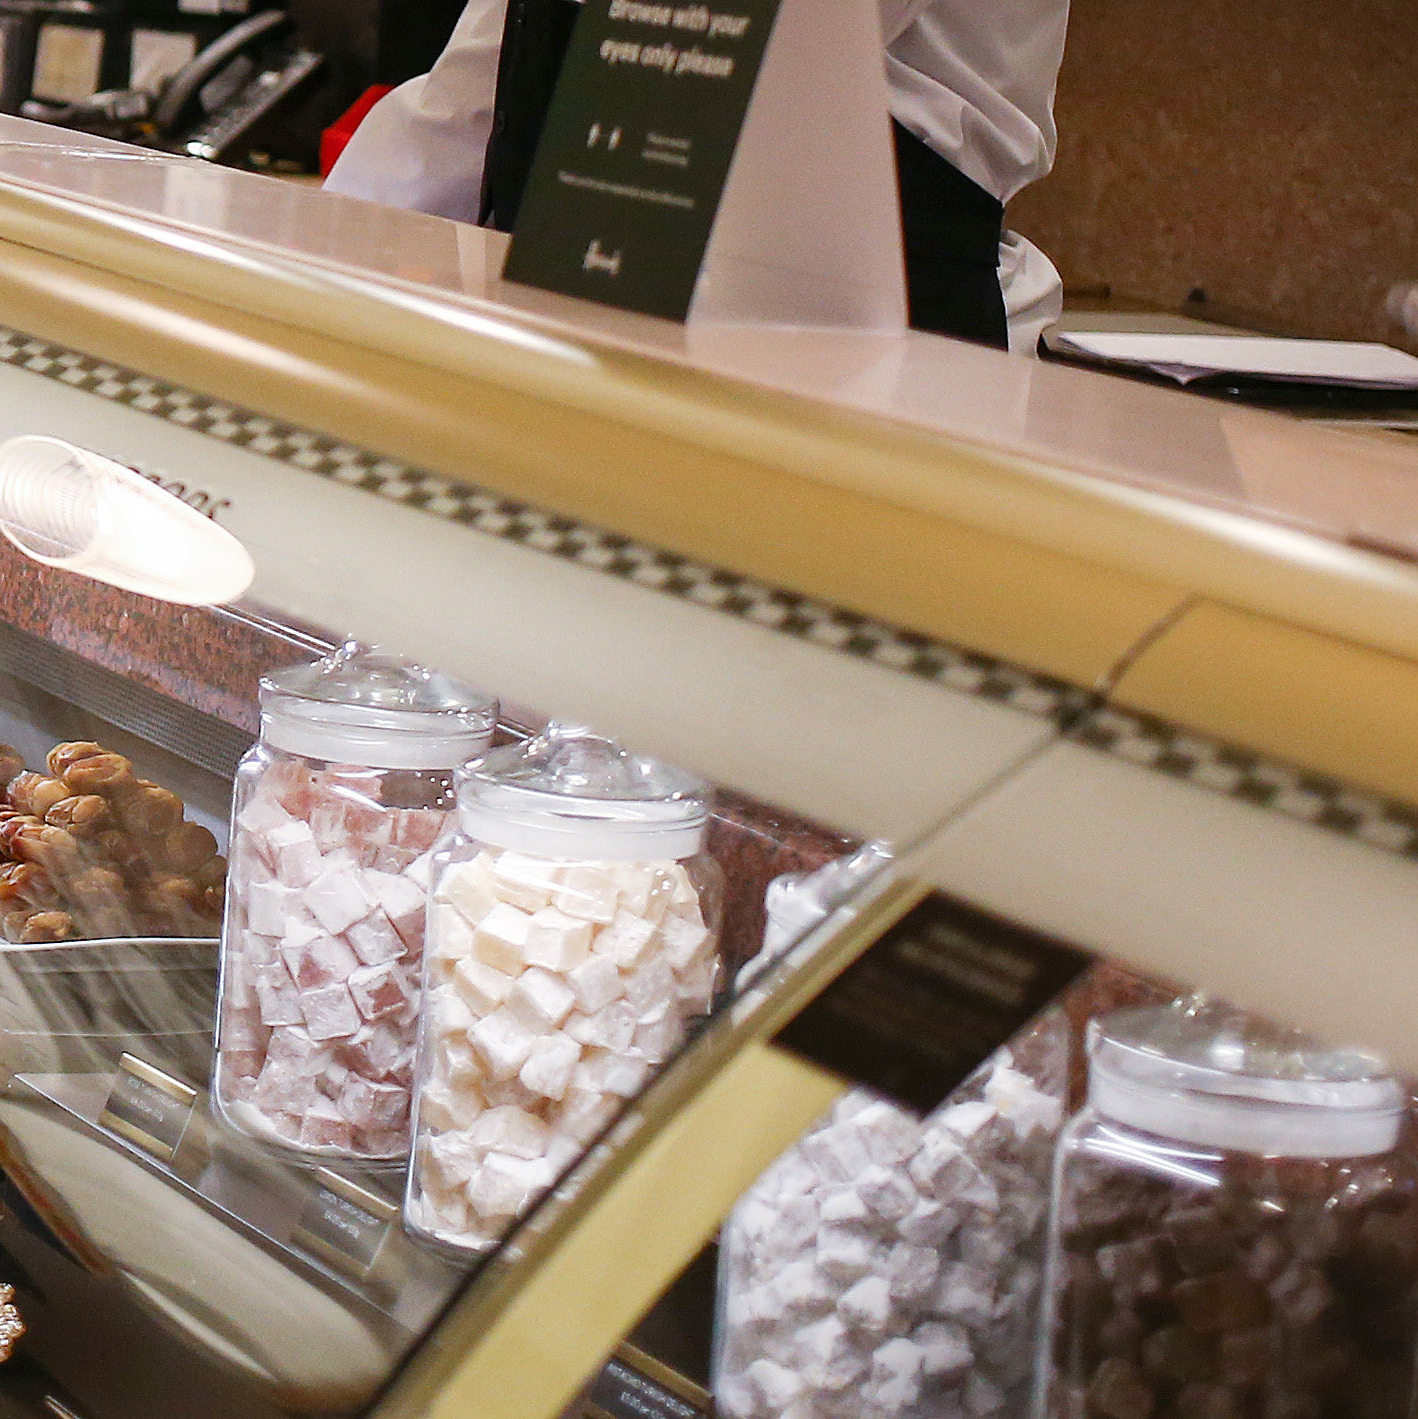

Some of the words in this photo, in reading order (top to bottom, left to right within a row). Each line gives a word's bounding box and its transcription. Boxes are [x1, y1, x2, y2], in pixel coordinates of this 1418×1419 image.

[672, 4, 709, 31] with
[707, 13, 751, 38] your
[600, 39, 641, 64] eyes
[640, 42, 678, 74] only
[675, 46, 734, 78] please
